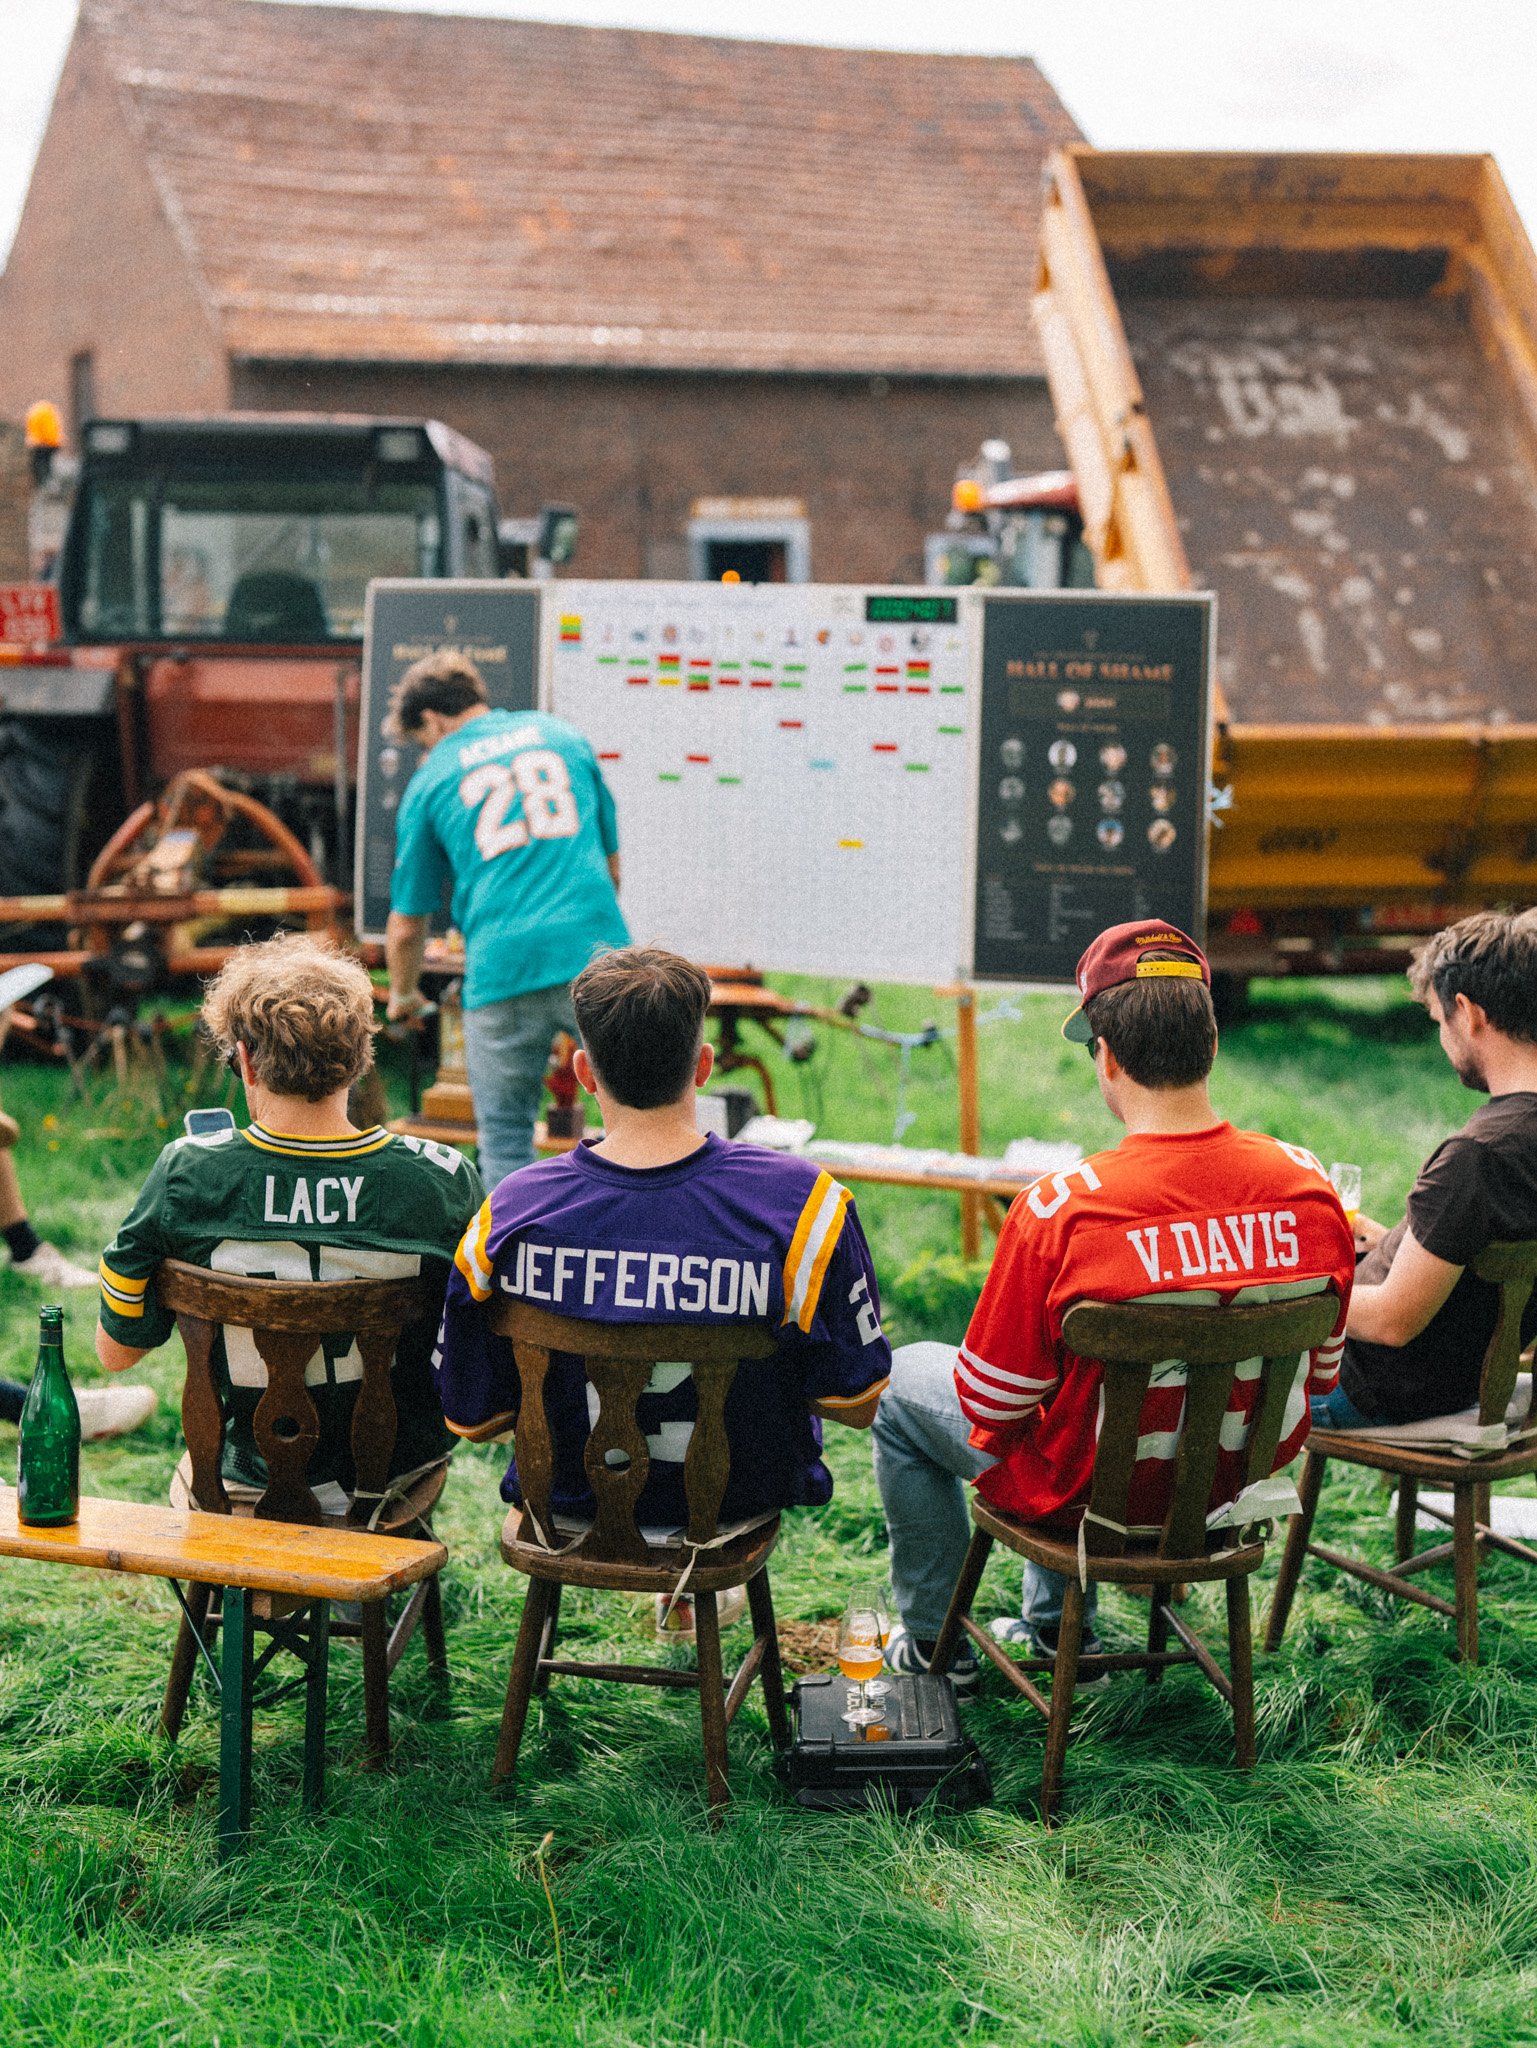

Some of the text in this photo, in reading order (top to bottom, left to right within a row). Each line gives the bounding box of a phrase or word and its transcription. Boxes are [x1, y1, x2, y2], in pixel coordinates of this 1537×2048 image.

[458, 749, 580, 862] 28
[264, 1175, 364, 1224] LACY
[500, 1242, 771, 1316] JEFFERSON
